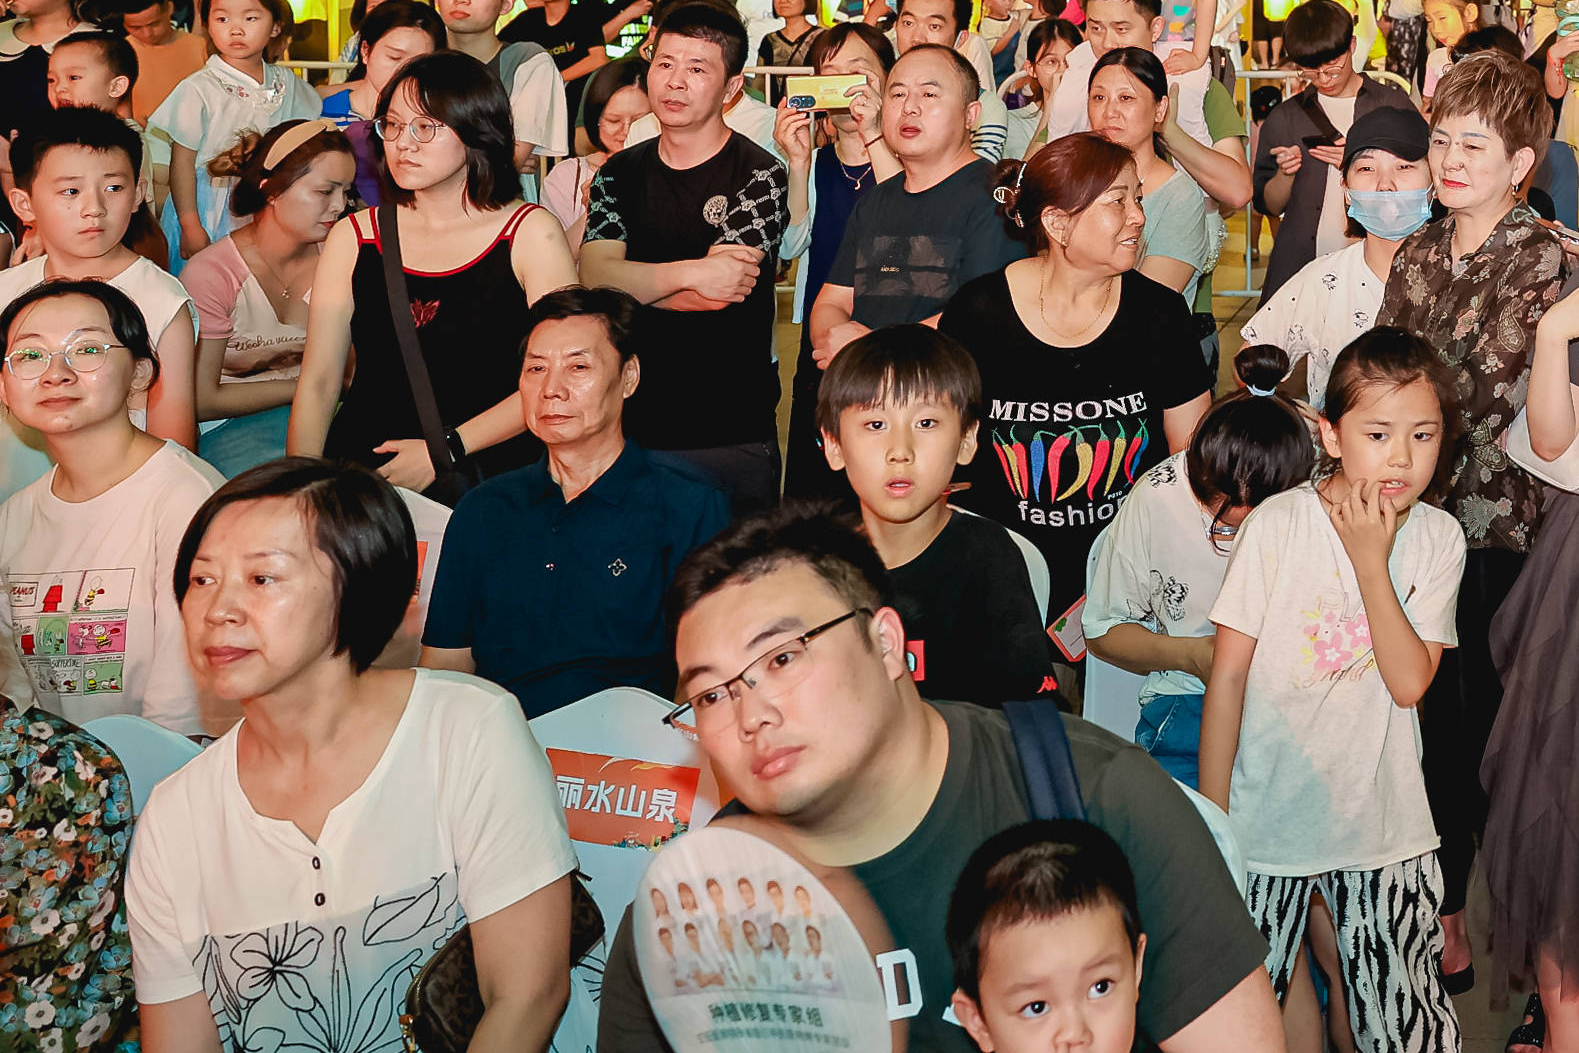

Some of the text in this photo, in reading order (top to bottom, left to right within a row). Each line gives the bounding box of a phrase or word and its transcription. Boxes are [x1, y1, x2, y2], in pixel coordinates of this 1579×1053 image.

[988, 391, 1148, 423] MISSONE
[555, 775, 678, 824] 丽水山泉
